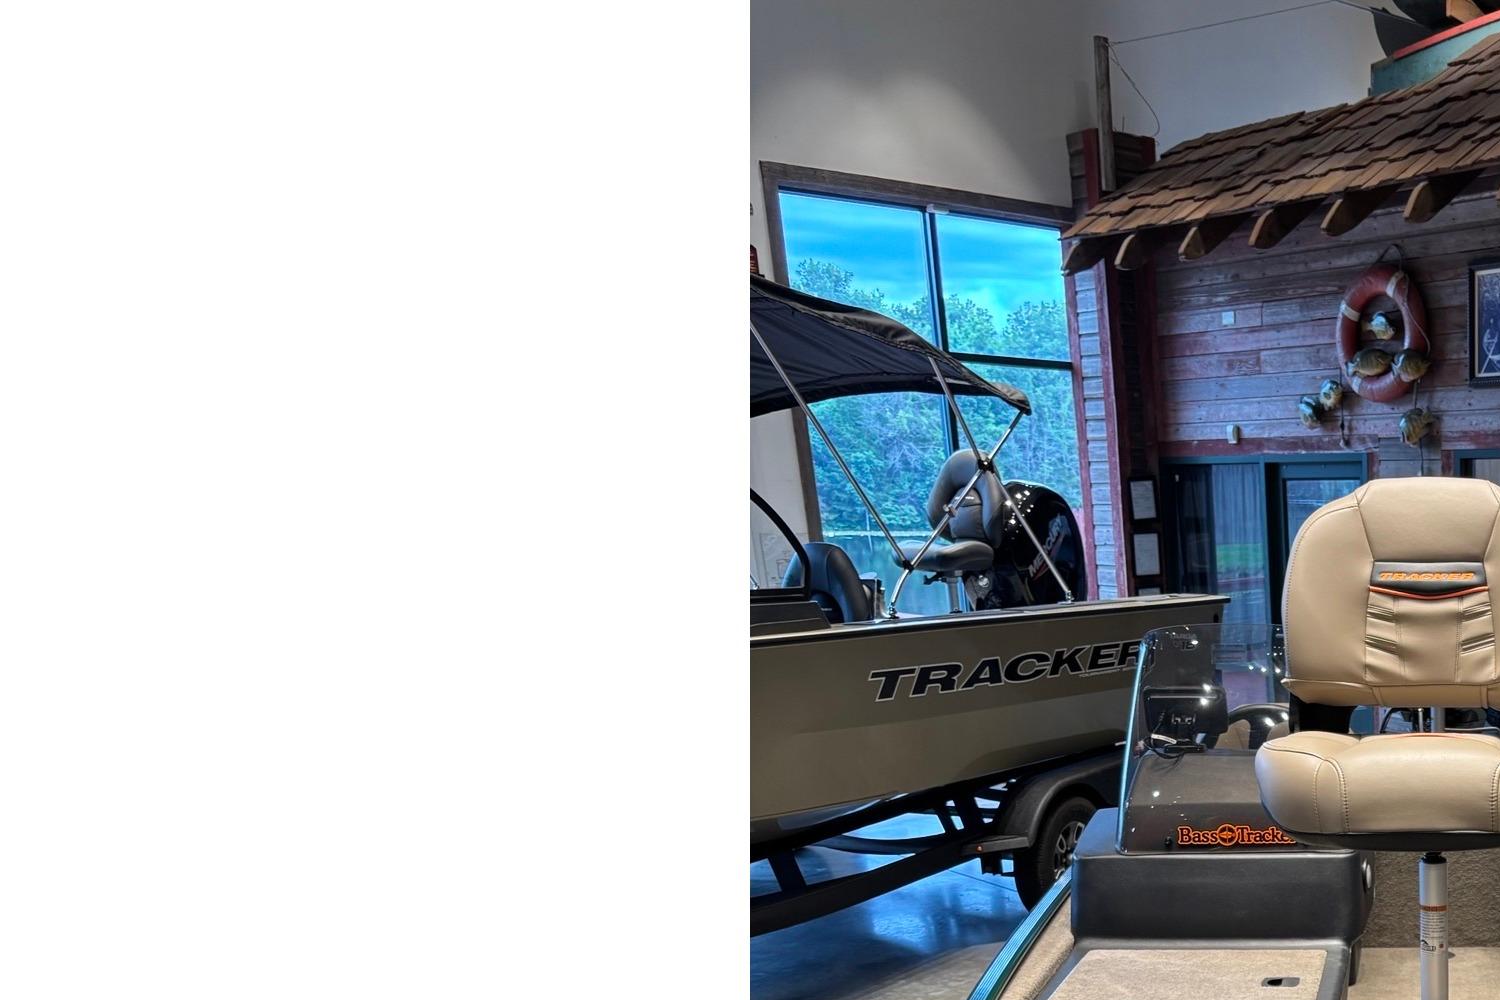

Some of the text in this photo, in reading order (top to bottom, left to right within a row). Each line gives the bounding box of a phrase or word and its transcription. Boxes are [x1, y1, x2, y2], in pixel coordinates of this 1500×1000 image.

[1380, 572, 1475, 581] TRACKER
[868, 638, 1154, 702] TRACKER
[1178, 825, 1296, 844] Bass Tracke
